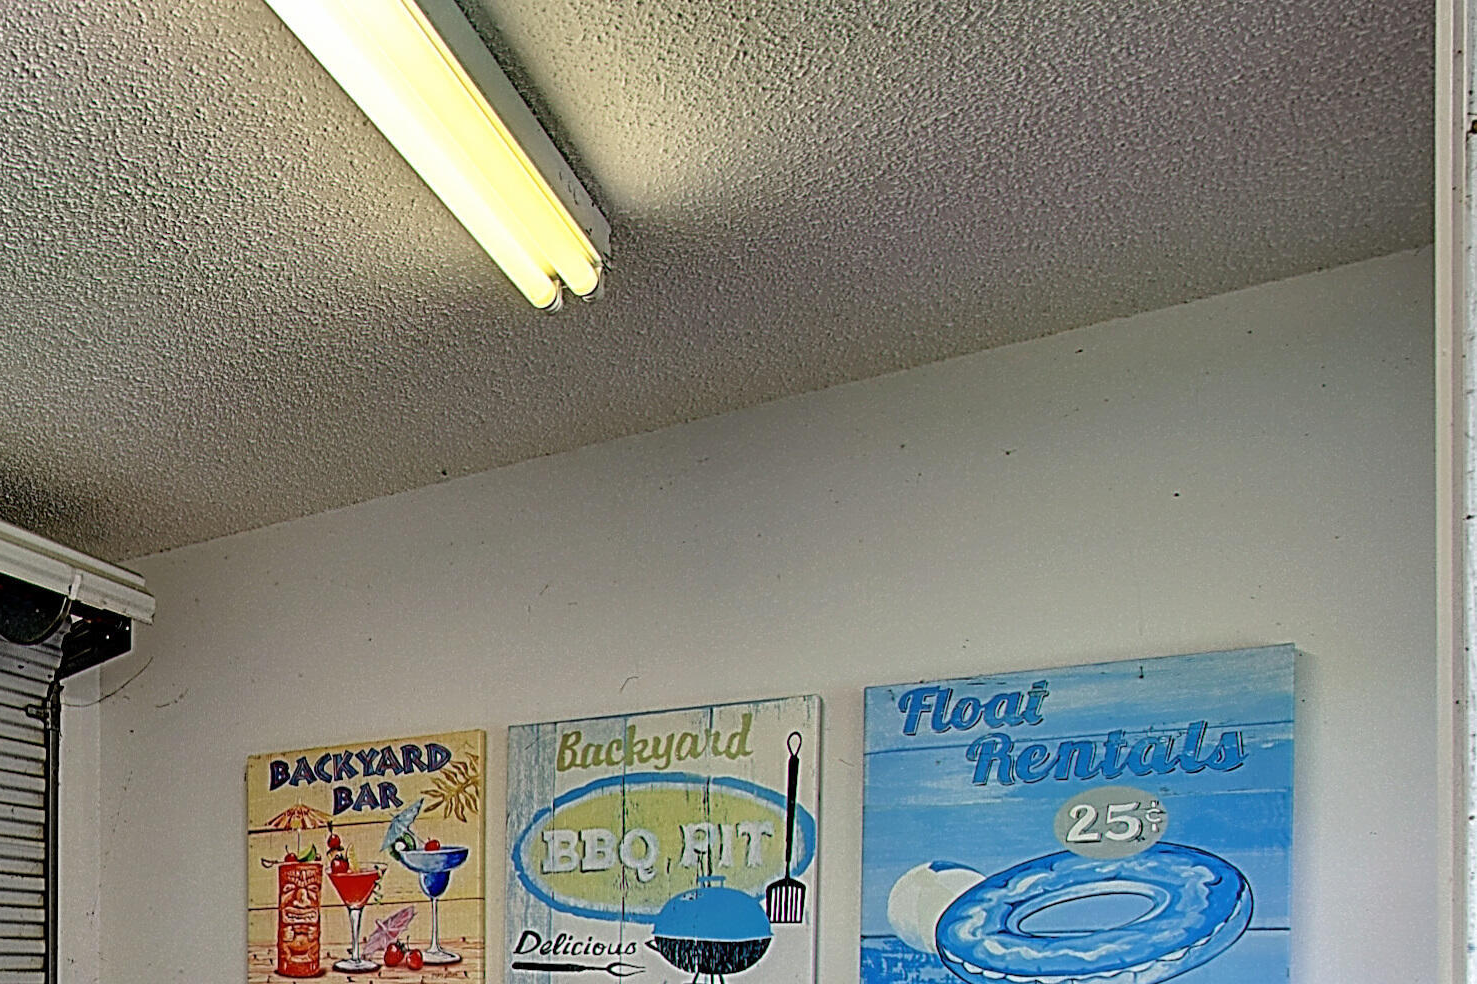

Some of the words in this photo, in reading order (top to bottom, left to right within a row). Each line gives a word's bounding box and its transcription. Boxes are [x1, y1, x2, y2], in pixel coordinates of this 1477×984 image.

[898, 680, 1049, 736] Float
[269, 743, 452, 791] BACKYARD
[556, 713, 754, 772] Backyard
[965, 720, 1250, 786] Rentals
[333, 781, 404, 816] BAR
[541, 828, 660, 883] BBQ
[513, 930, 637, 956] Delicious
